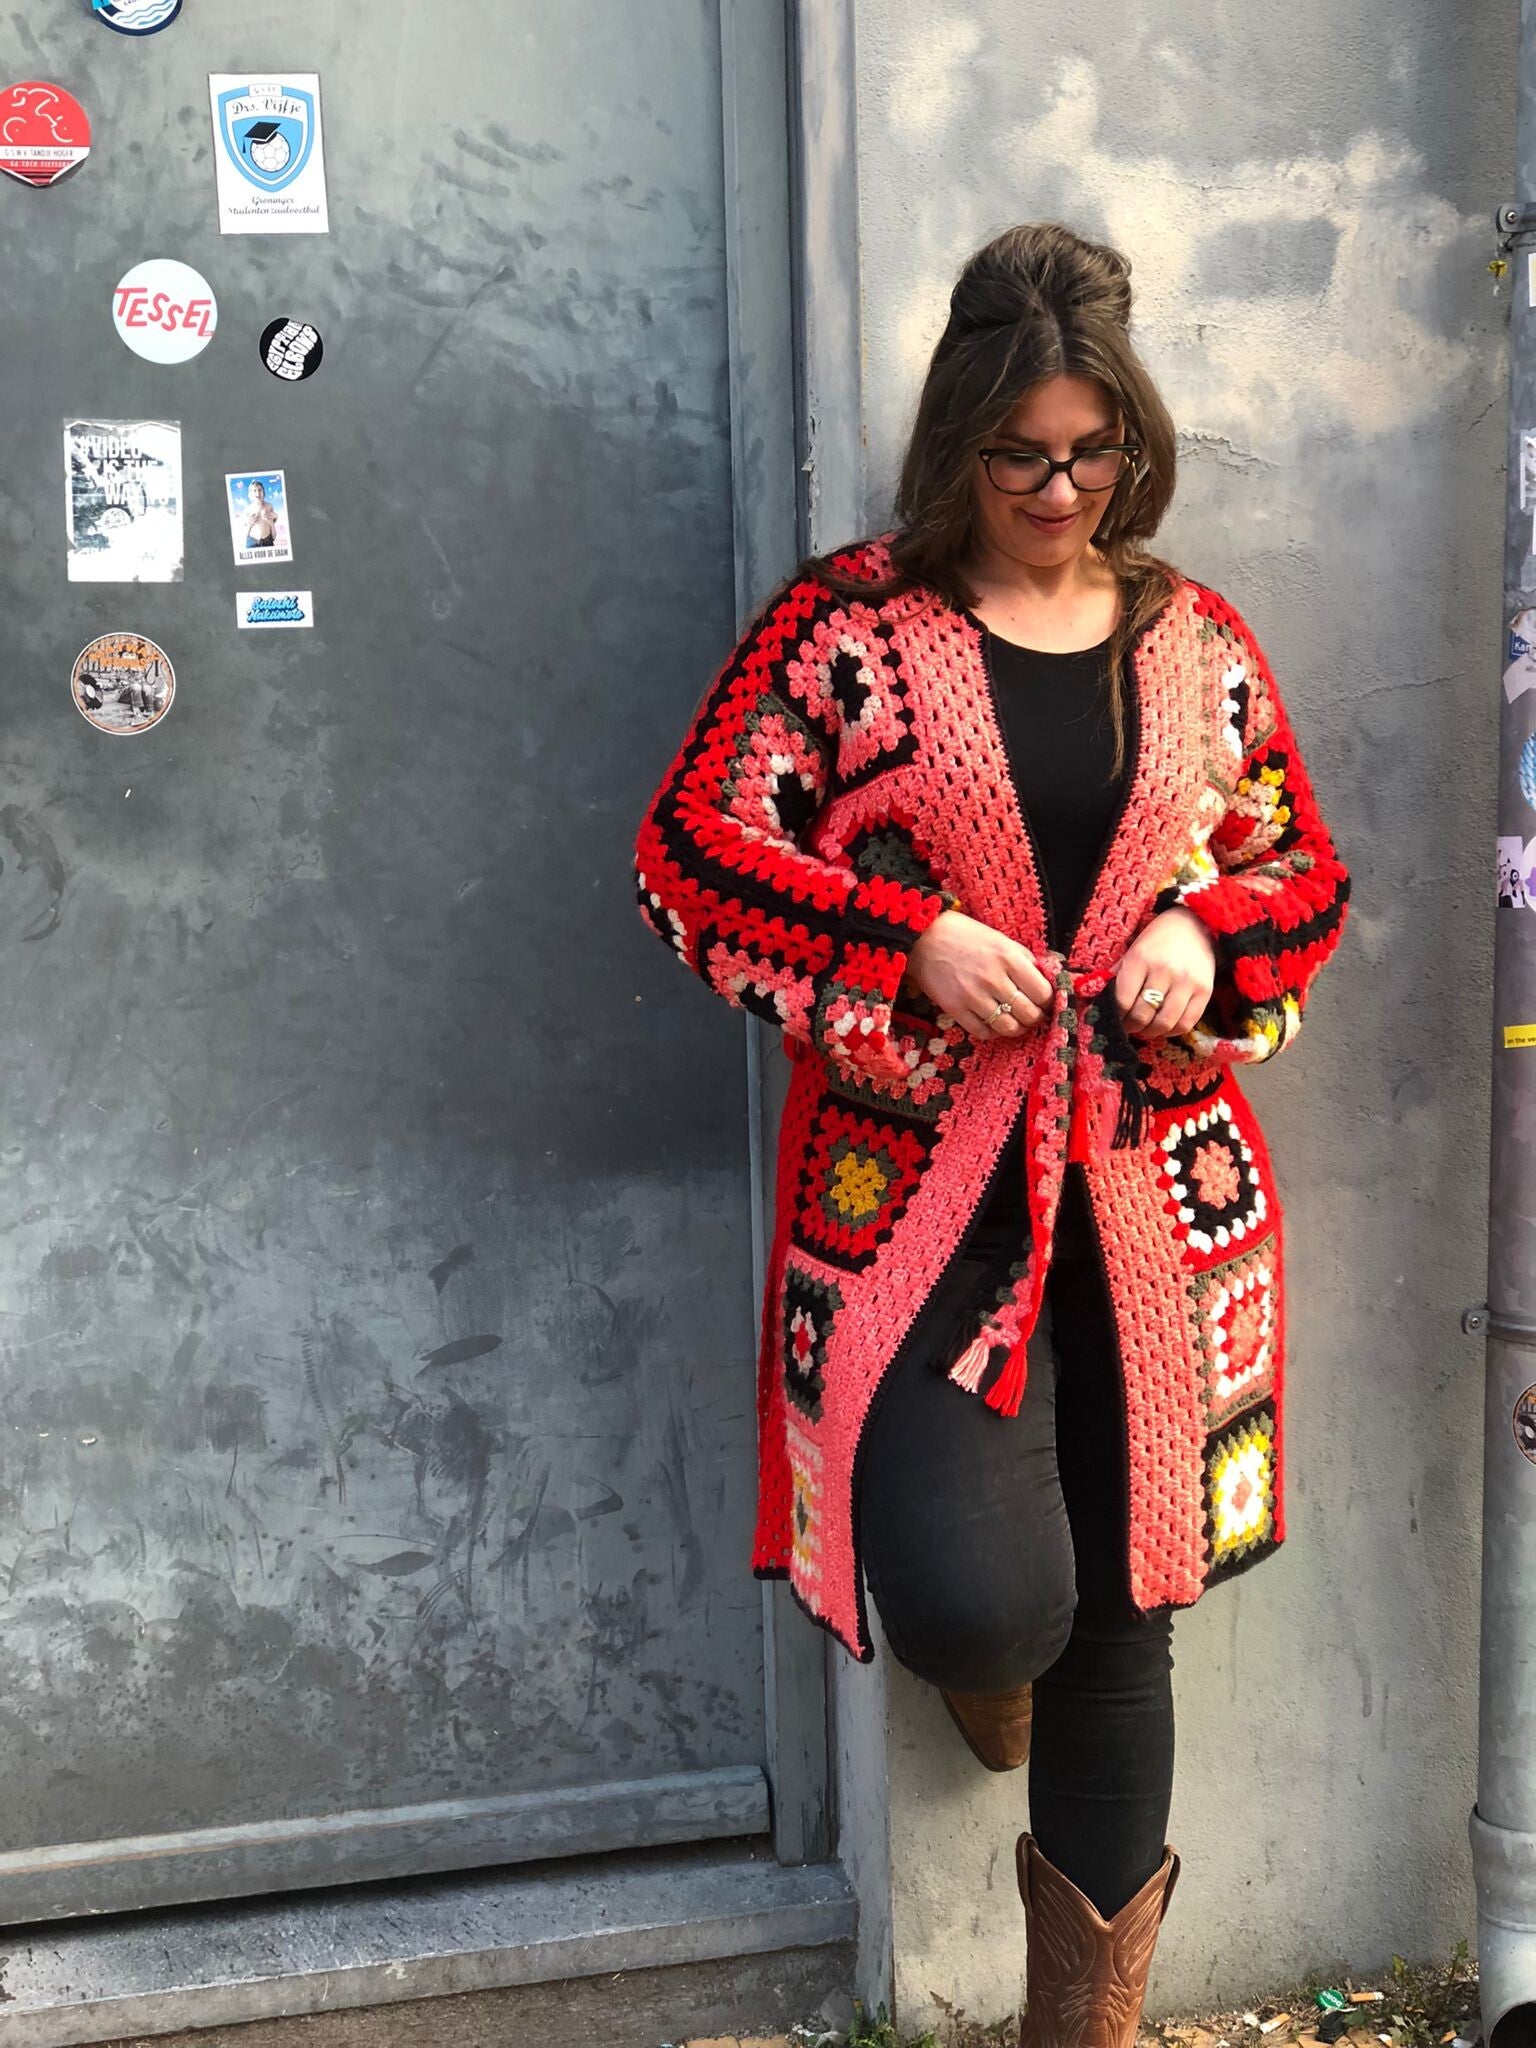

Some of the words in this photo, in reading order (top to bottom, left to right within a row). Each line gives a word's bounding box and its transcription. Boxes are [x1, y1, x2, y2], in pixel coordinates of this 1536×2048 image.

[113, 287, 216, 336] TESSEL
[239, 551, 253, 560] ALLES
[254, 550, 266, 559] VOOR
[252, 596, 298, 610] Satoshi
[247, 608, 305, 623] Nakamoto
